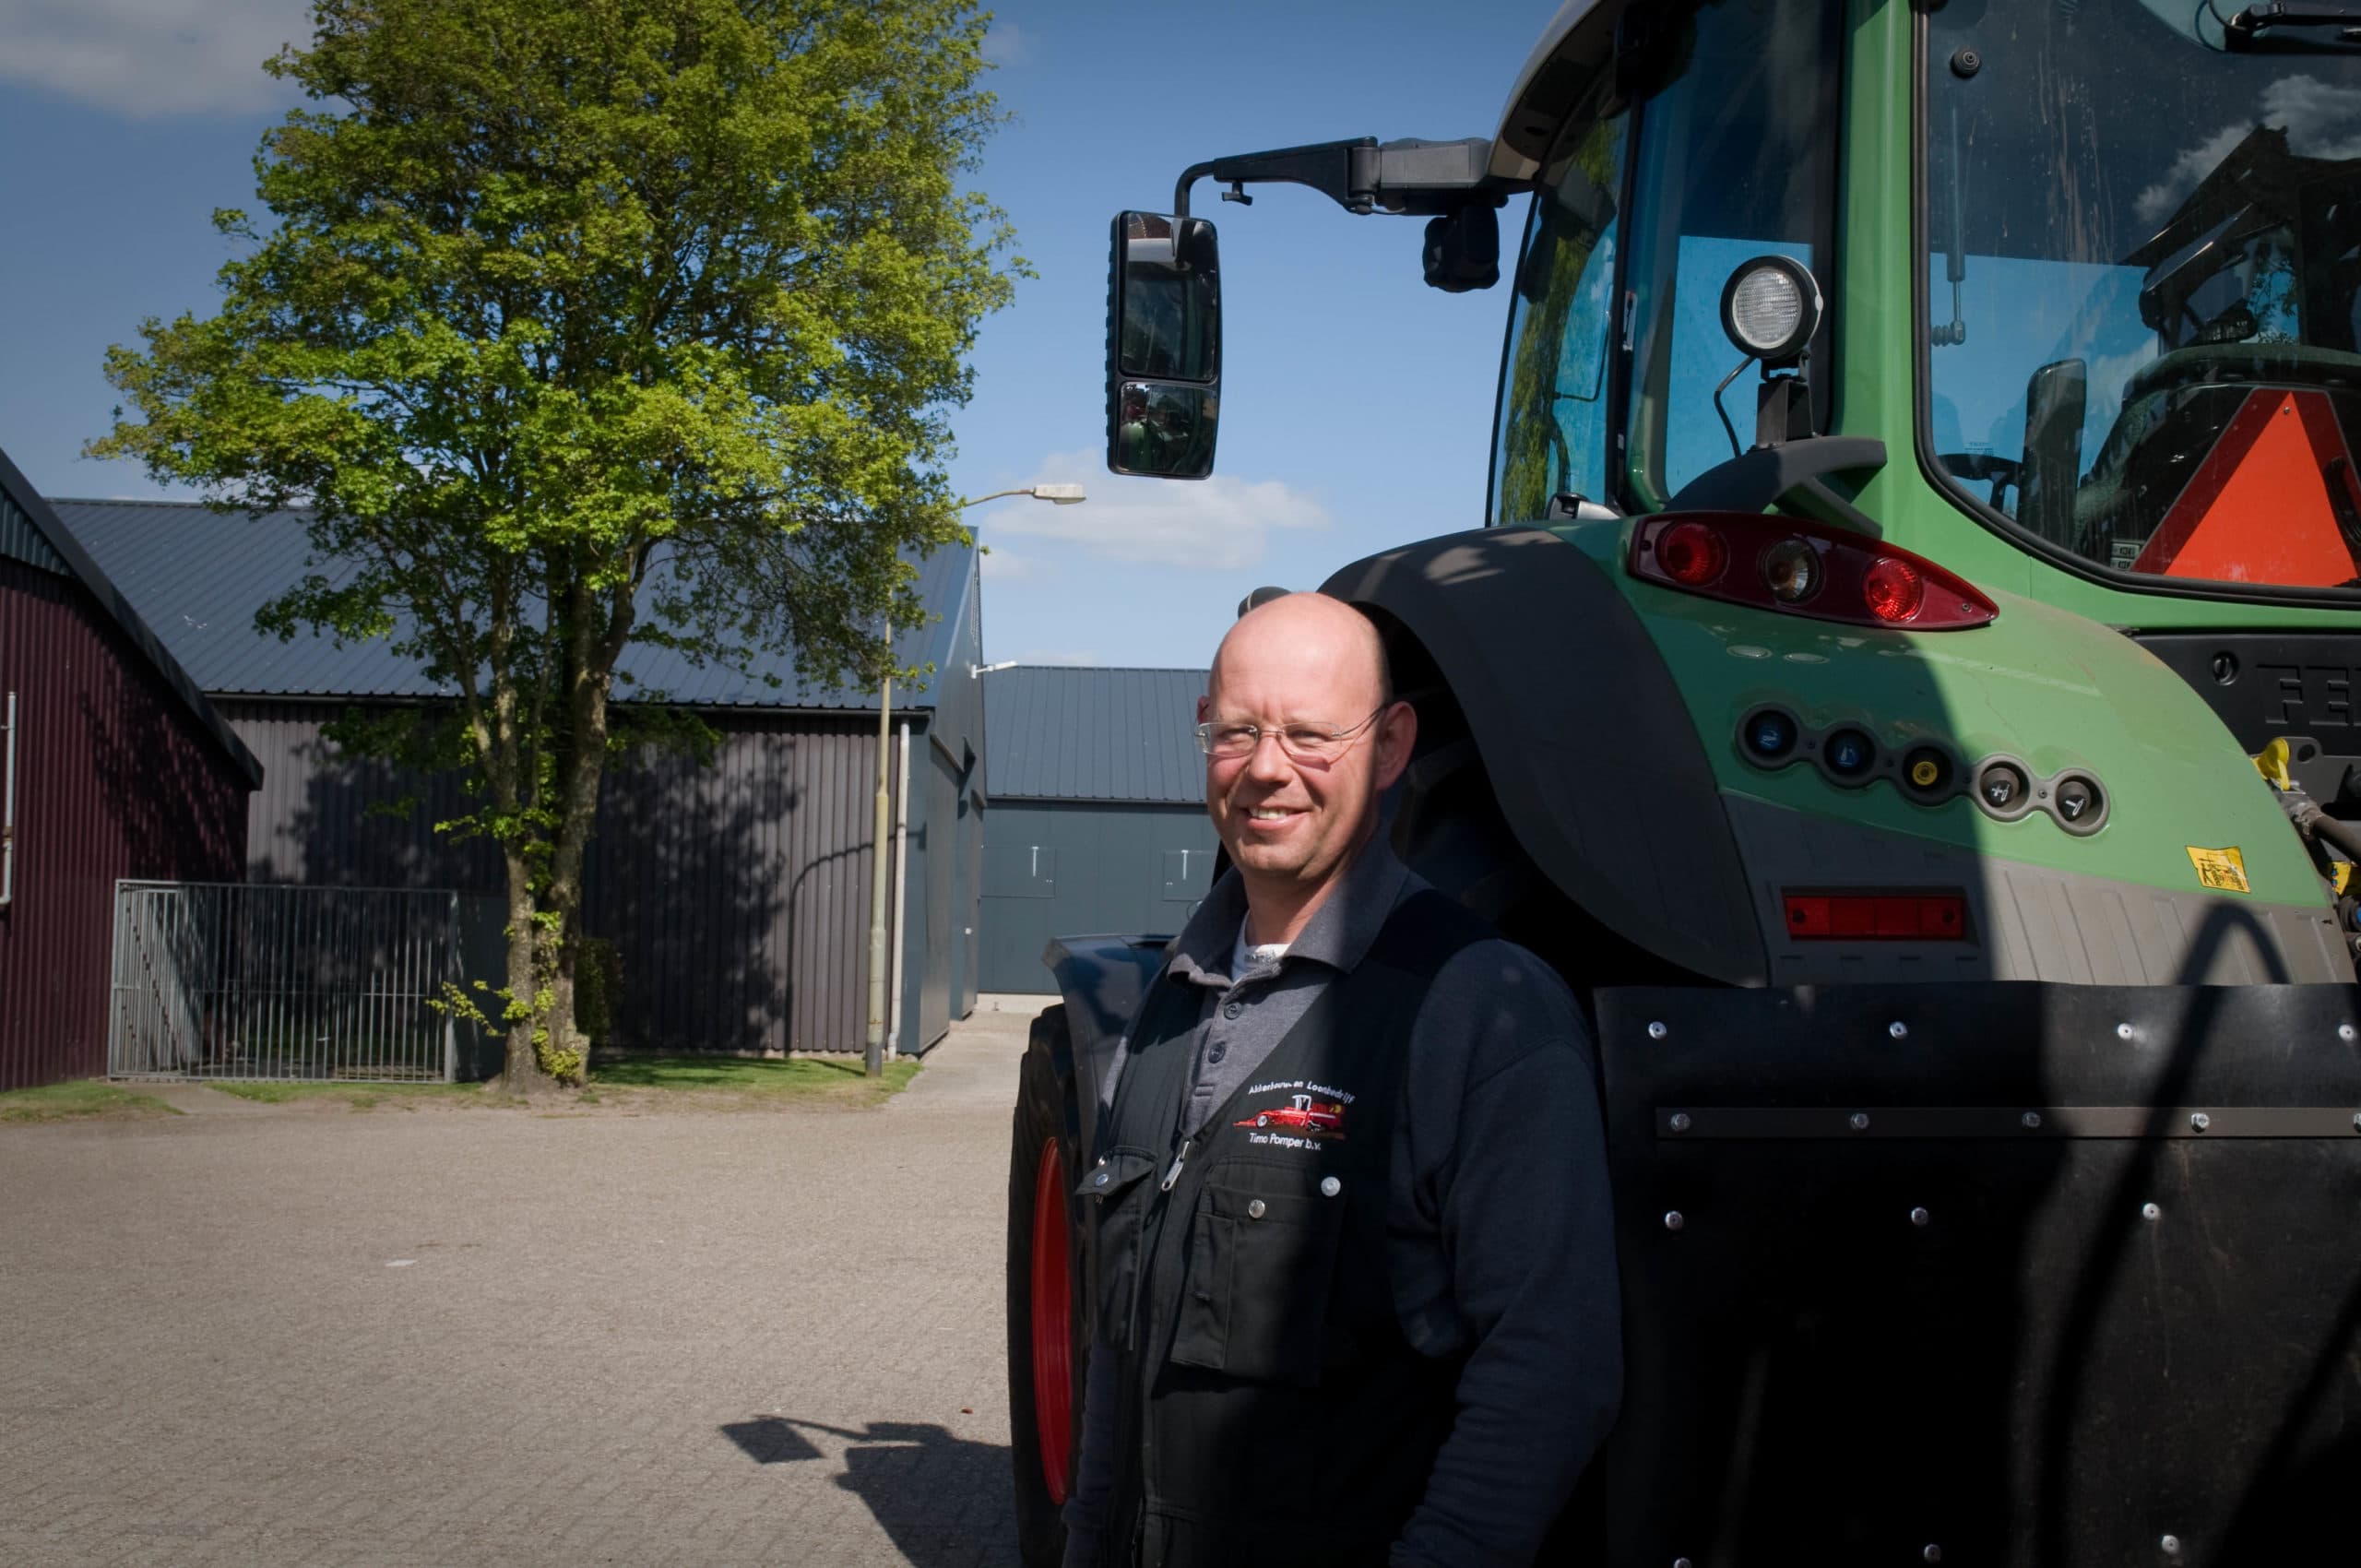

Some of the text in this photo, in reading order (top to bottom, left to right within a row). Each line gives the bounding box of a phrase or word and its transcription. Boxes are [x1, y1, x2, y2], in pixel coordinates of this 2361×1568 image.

[2255, 663, 2361, 727] FE
[1293, 1080, 1304, 1088] en
[1306, 1080, 1356, 1104] Loonbedrijf
[1249, 1132, 1269, 1145] Timo
[1269, 1133, 1304, 1149] Pomper
